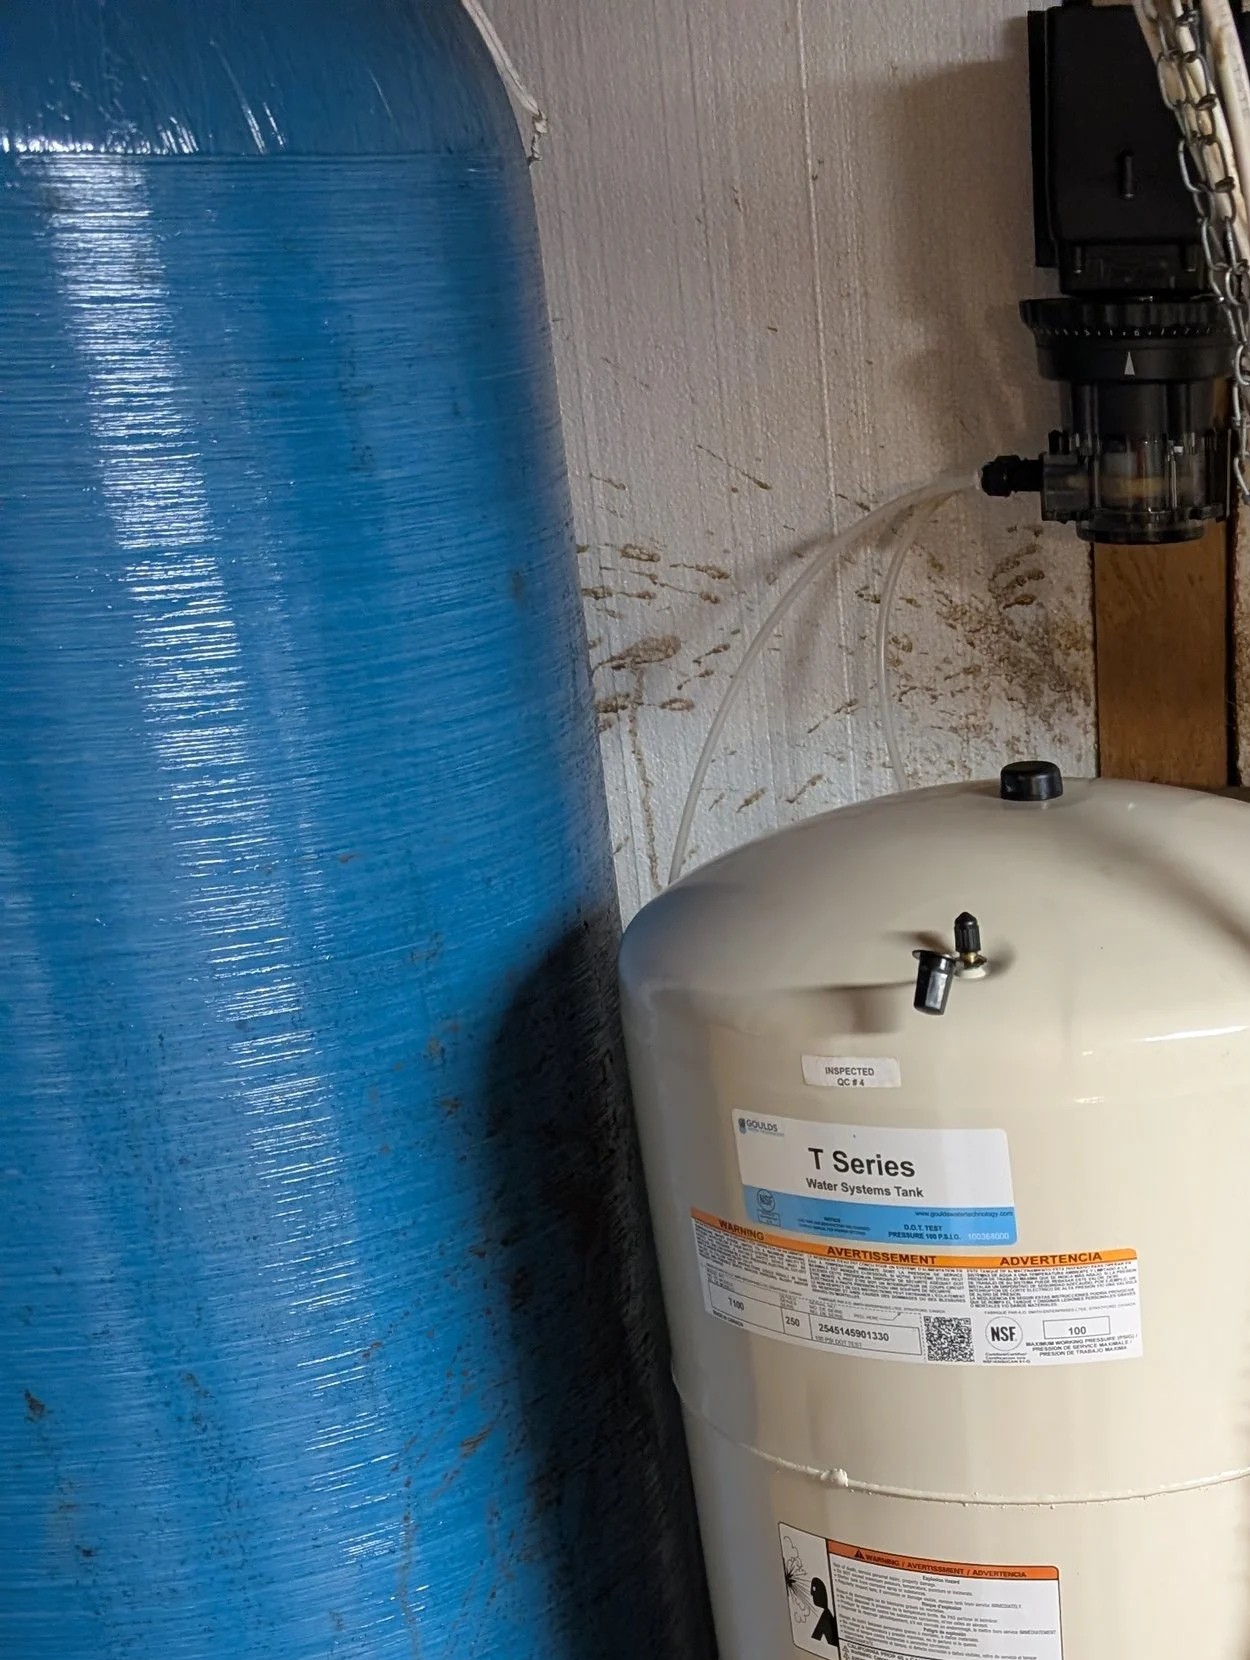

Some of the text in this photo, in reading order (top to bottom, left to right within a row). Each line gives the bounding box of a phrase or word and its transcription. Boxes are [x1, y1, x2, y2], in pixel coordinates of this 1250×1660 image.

[825, 1066, 874, 1076] INSPECTED
[837, 1078, 850, 1087] QC
[859, 1079, 865, 1087] 4
[746, 1119, 778, 1132] GOULDS
[808, 1147, 917, 1178] T Series
[806, 1178, 924, 1198] Water Systems Tank
[758, 1194, 774, 1207] NSF
[888, 1231, 924, 1239] PRESSURE
[719, 1219, 1103, 1266] WARNING AVERTISSEMENT ADVERTENCIA
[728, 1297, 745, 1310] T100
[785, 1316, 800, 1327] 250
[818, 1324, 890, 1341] 2545145901330
[991, 1326, 1016, 1342] NSF
[1068, 1326, 1086, 1336] 100
[865, 1554, 900, 1567] WARNING
[972, 1570, 1027, 1578] ADVERTENCIA
[847, 1643, 879, 1656] CALIFORNIA
